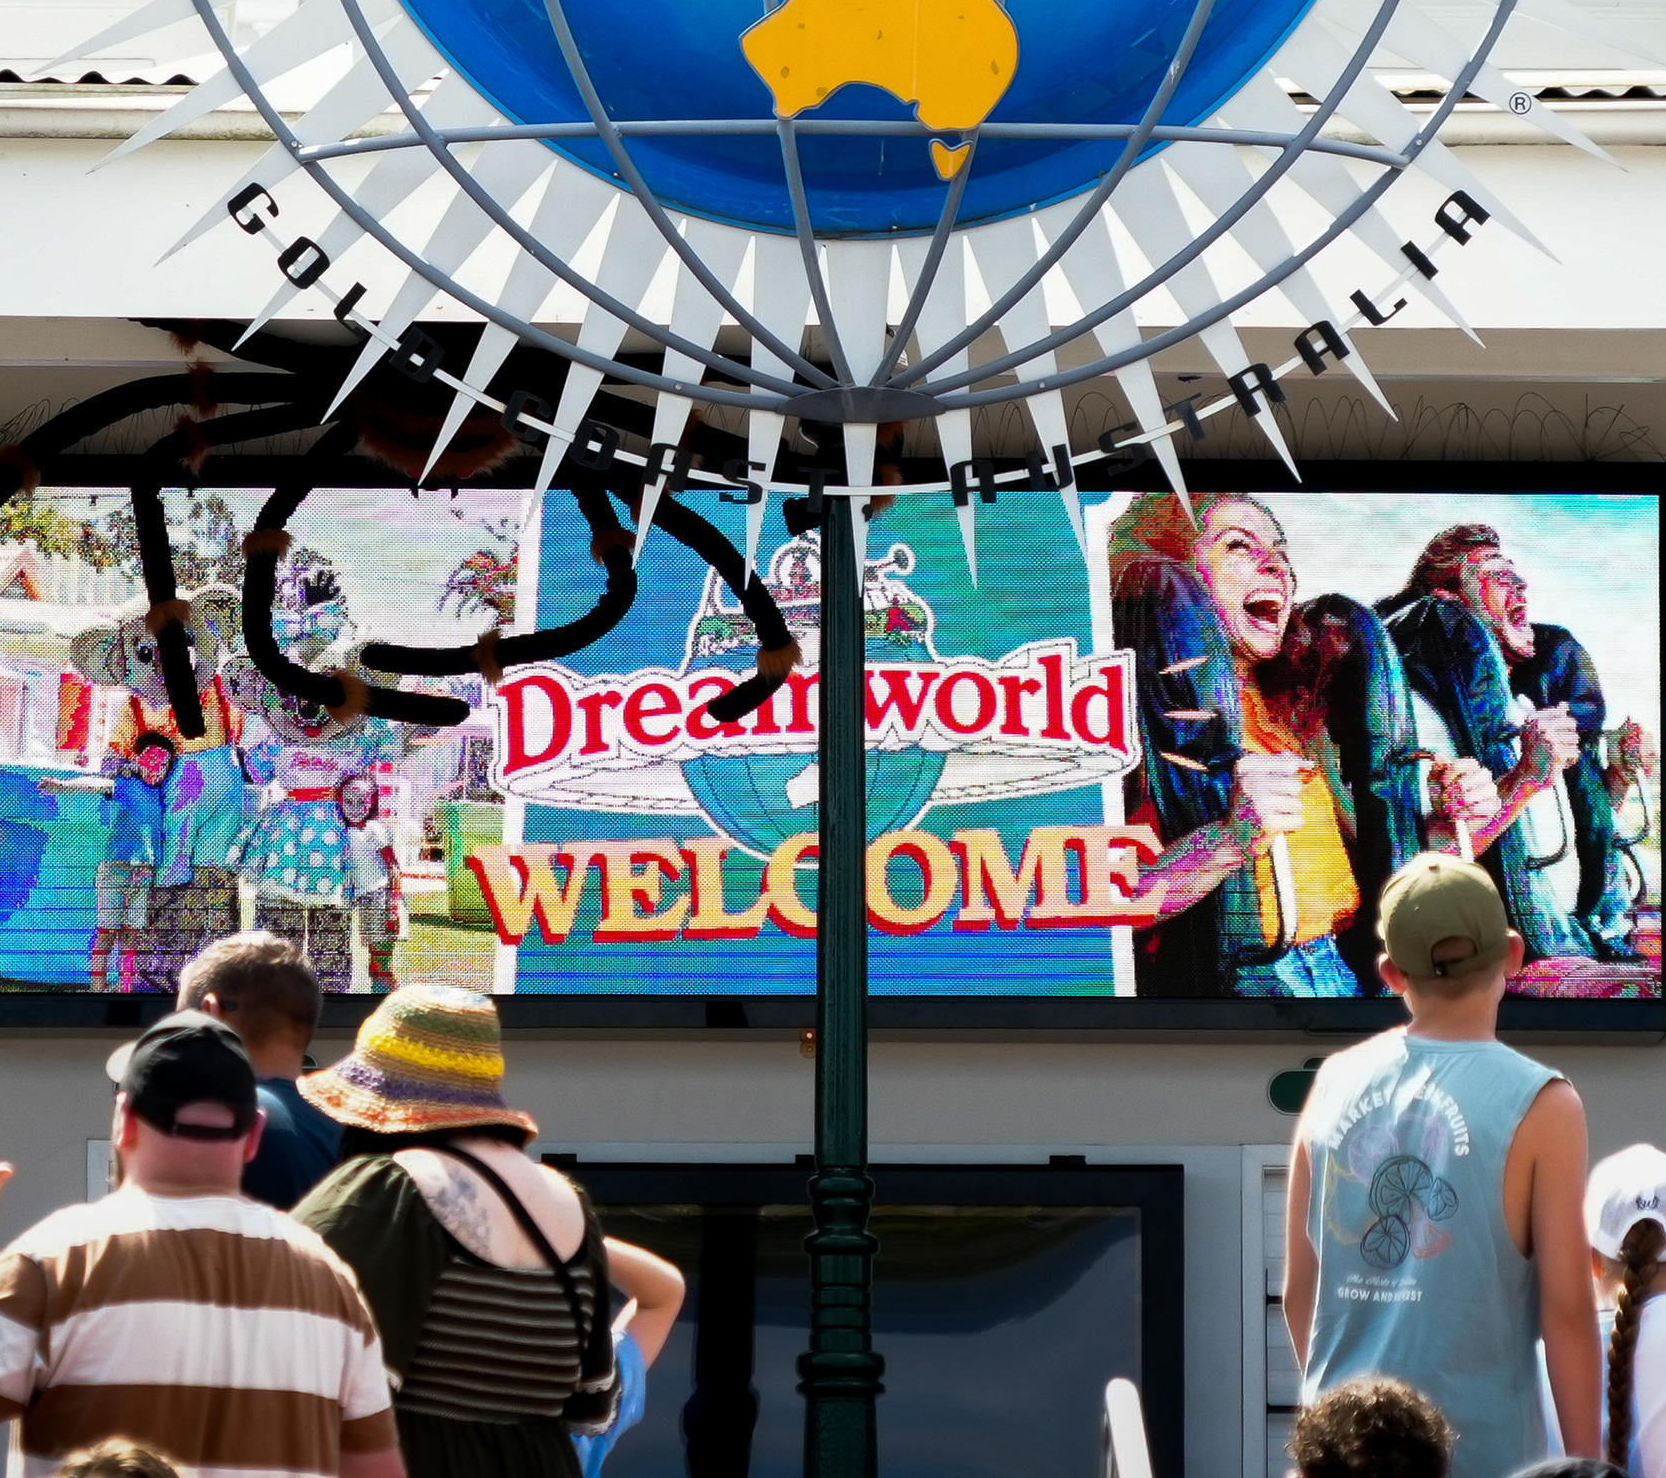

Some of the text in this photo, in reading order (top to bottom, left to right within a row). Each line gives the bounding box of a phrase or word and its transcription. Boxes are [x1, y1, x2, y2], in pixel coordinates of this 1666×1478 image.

[228, 182, 446, 383] GOLD
[950, 188, 1491, 507] AUSTRALIA
[466, 823, 1167, 944] WELCOME
